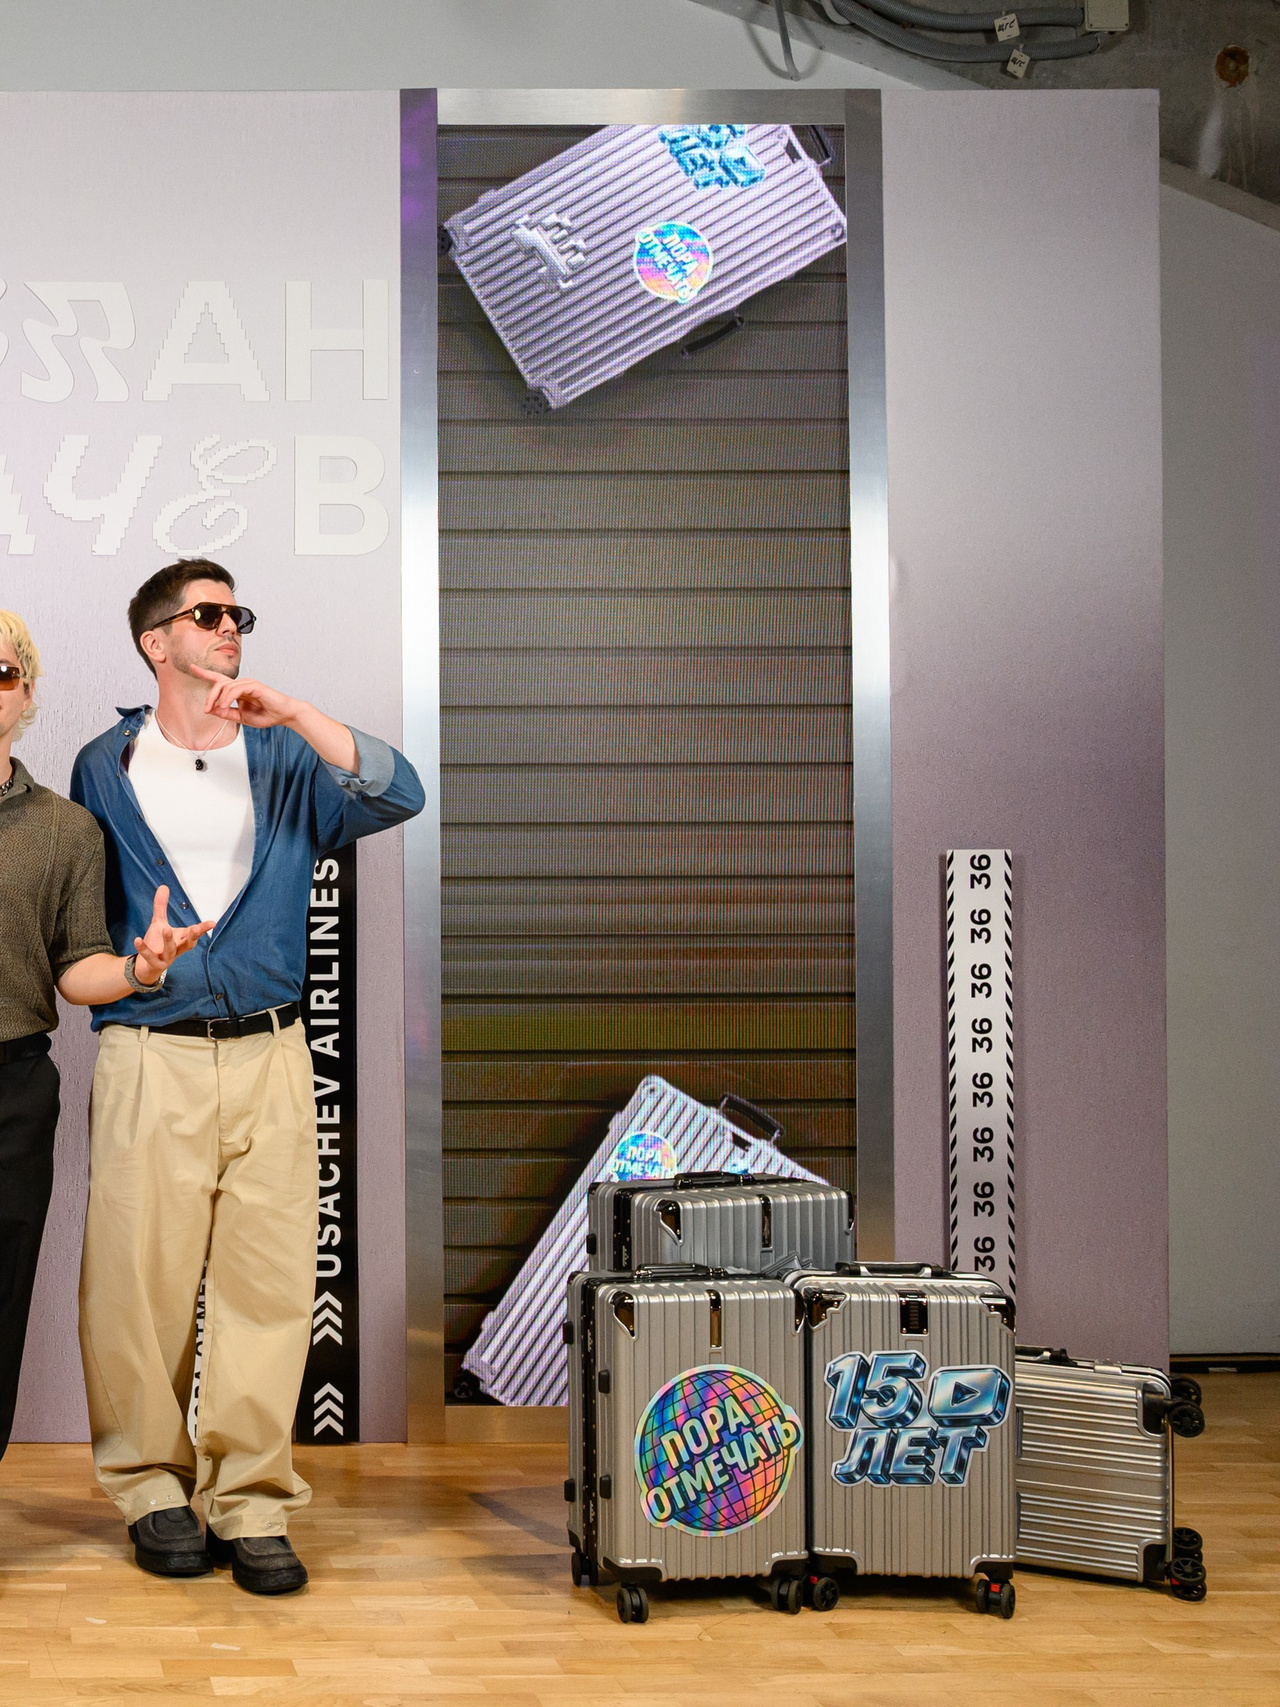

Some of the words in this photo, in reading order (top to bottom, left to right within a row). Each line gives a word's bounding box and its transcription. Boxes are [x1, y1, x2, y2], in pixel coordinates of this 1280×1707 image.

[662, 232, 699, 276] ПОРА
[970, 854, 991, 890] 36
[971, 908, 992, 944] 36
[309, 857, 341, 1059] AIRLINES
[971, 963, 992, 999] 36
[972, 1017, 993, 1053] 36
[973, 1072, 994, 1108] 36
[973, 1126, 994, 1162] 36
[315, 1072, 343, 1280] USACHEV
[974, 1181, 995, 1217] 36
[975, 1236, 996, 1272] 36
[826, 1350, 926, 1430] 15
[660, 1395, 752, 1469] ПОРА
[645, 1415, 800, 1521] ОТМЕЧАТЬ
[834, 1426, 987, 1485] ЛЕТ
